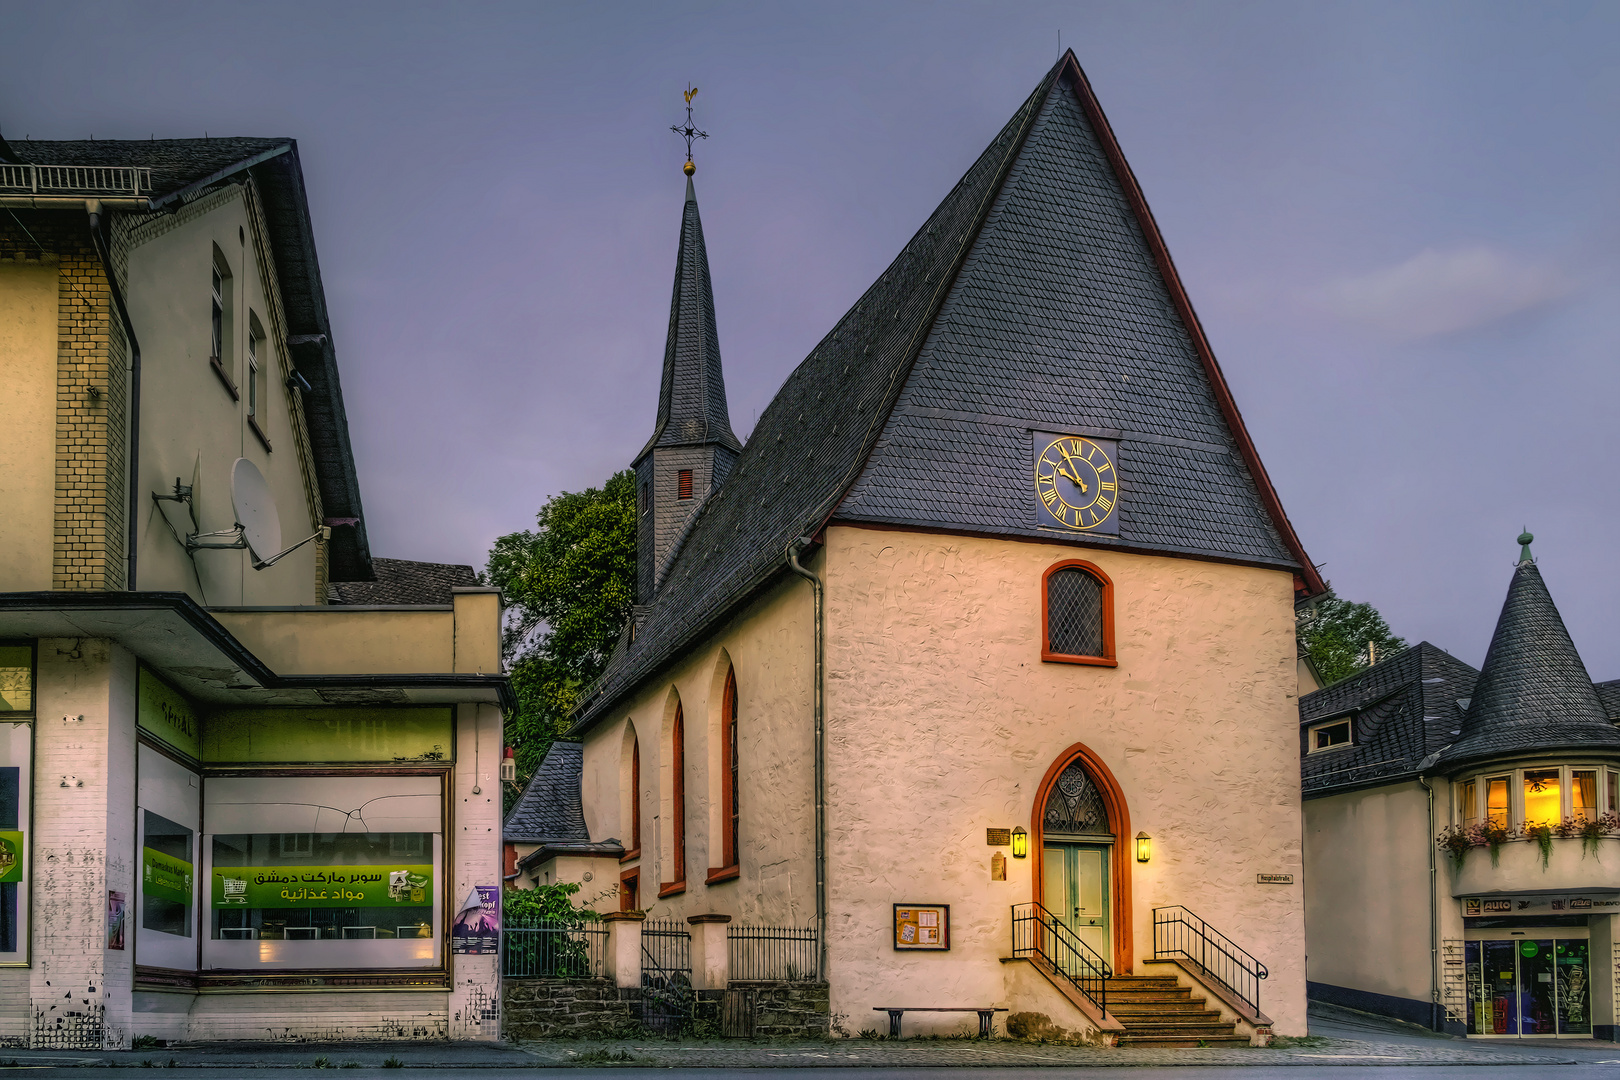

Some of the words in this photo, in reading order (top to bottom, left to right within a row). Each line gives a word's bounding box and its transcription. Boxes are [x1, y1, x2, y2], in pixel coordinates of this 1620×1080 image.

[1070, 439, 1082, 456] XII
[1088, 446, 1096, 461] I
[1097, 462, 1110, 474] II
[1102, 481, 1114, 491] III
[254, 870, 298, 885] دمشق
[301, 872, 346, 884] ماركت
[350, 873, 382, 885] سوبر
[280, 887, 327, 902] غذائية
[332, 888, 364, 902] مواد
